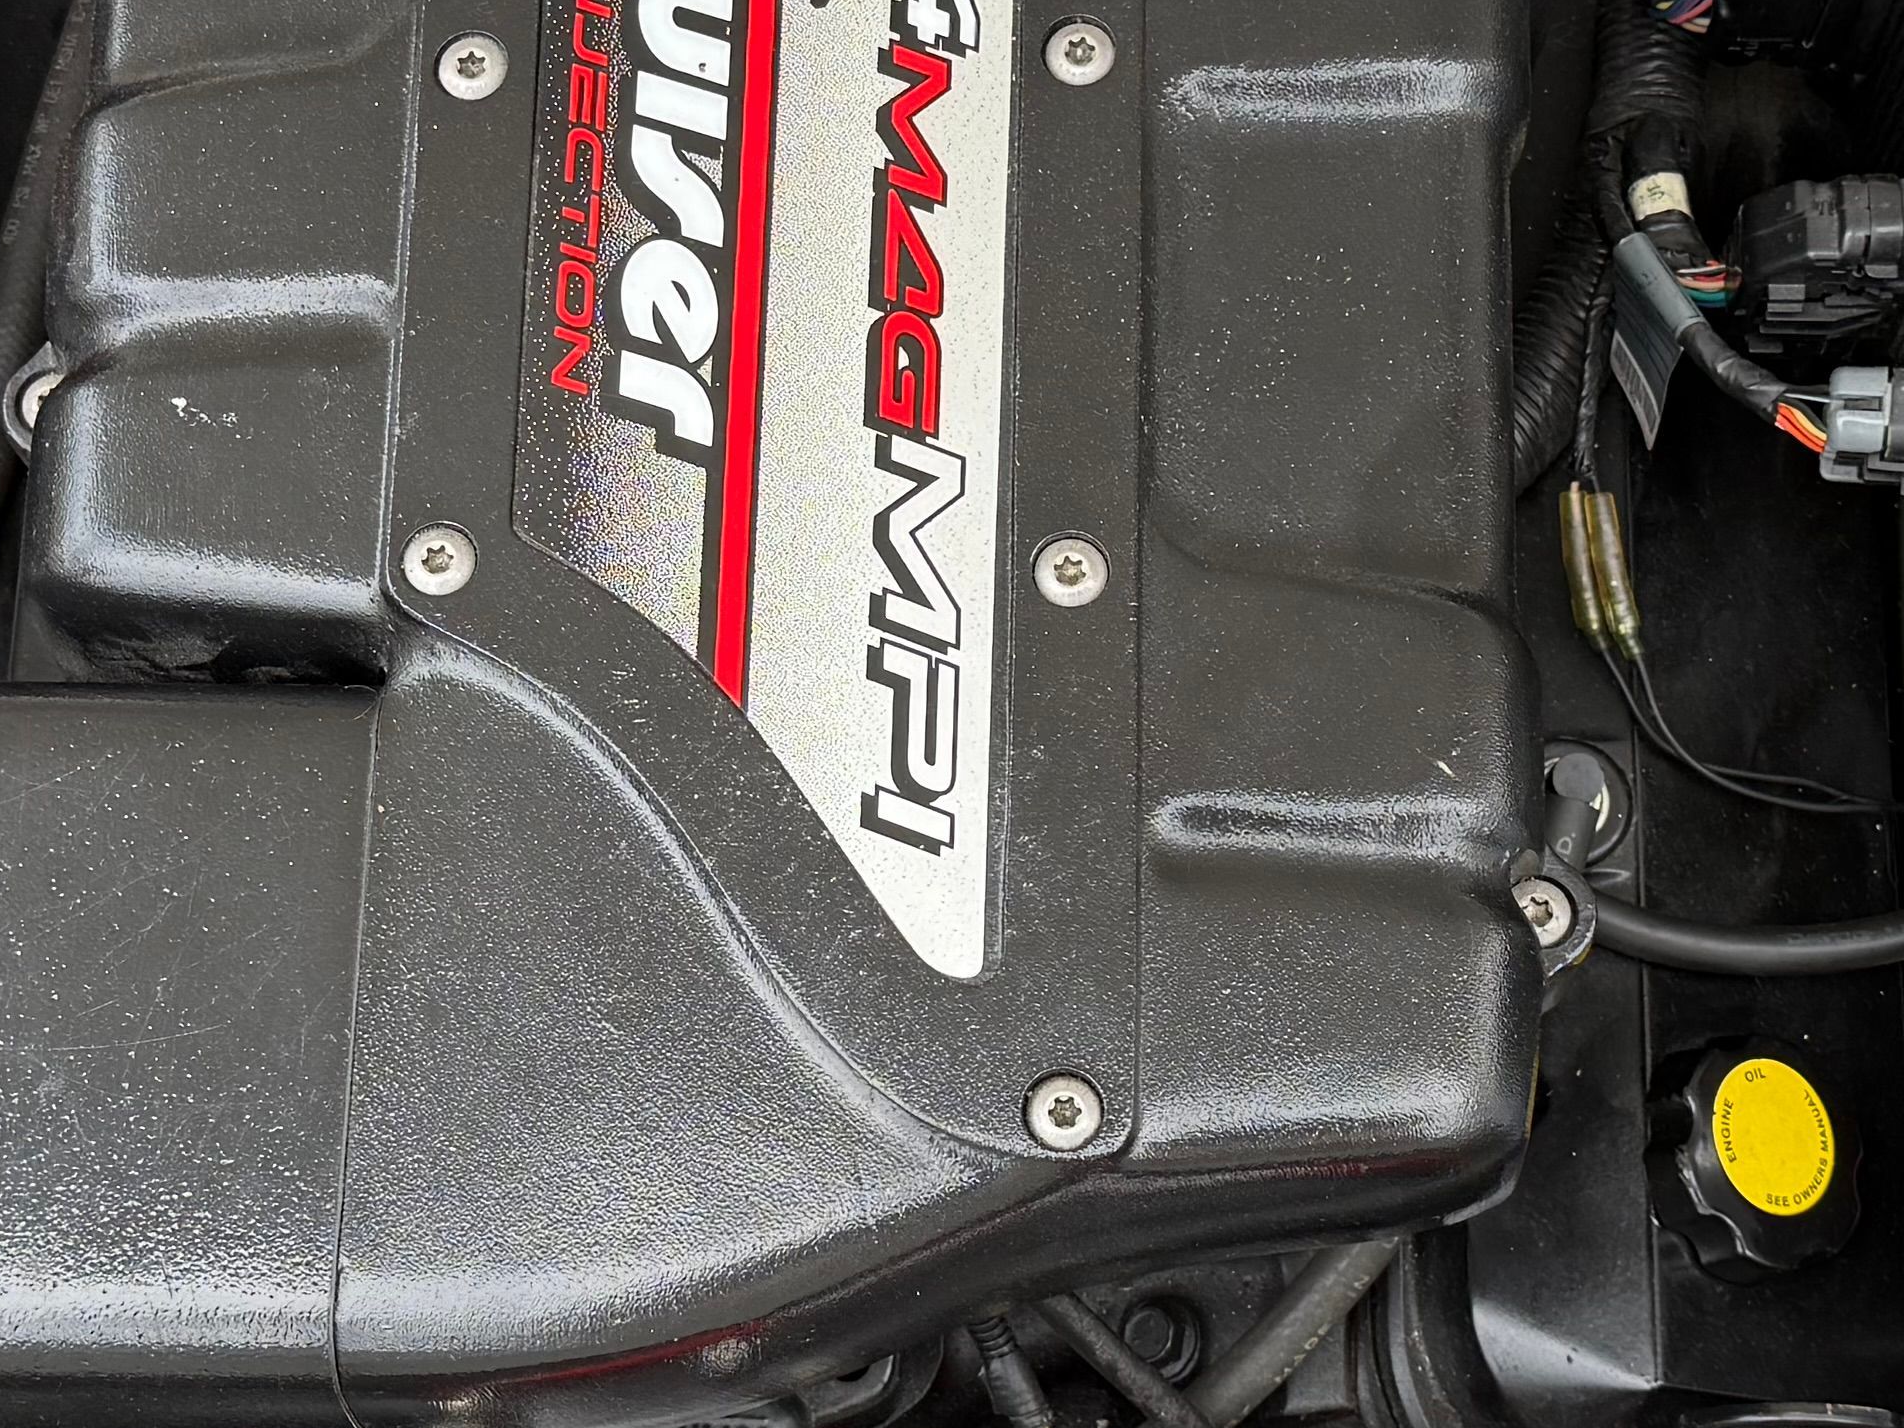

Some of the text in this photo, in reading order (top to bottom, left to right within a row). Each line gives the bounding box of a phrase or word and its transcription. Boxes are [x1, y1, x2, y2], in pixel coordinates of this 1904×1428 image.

[1720, 1067, 1767, 1164] ENGINE OIL
[1765, 1089, 1829, 1207] SEE OWNERS MANUAL
